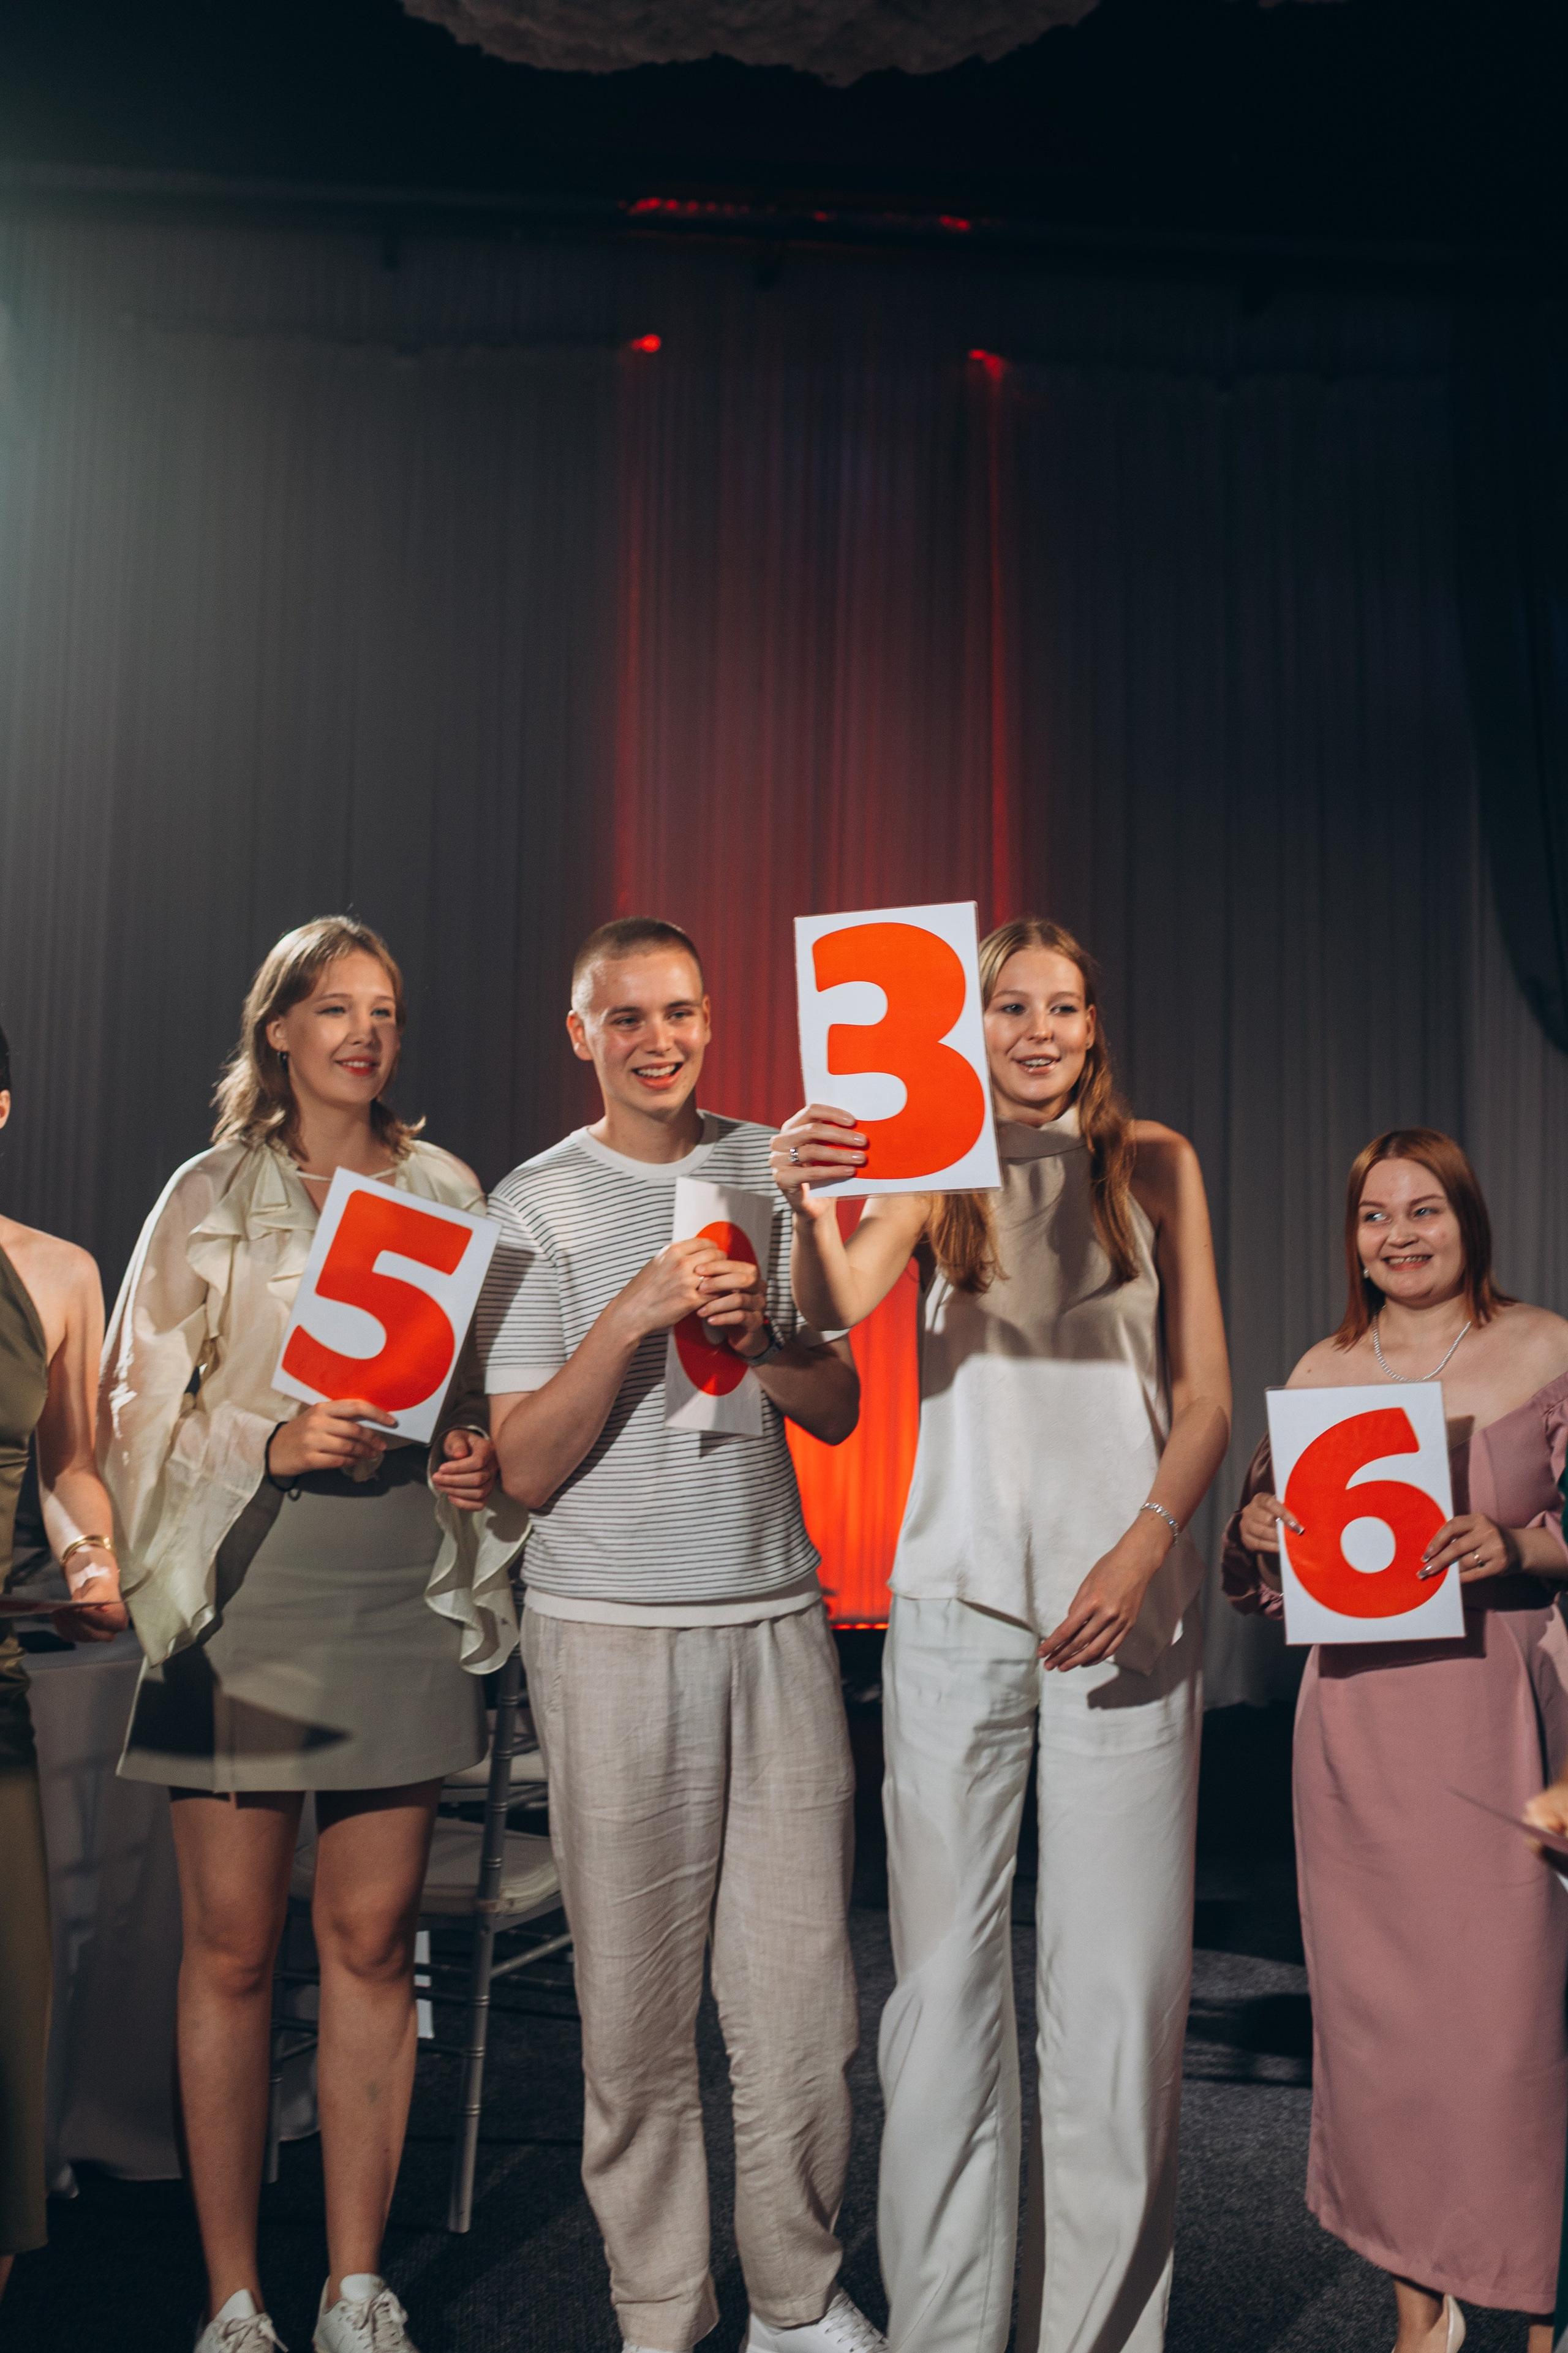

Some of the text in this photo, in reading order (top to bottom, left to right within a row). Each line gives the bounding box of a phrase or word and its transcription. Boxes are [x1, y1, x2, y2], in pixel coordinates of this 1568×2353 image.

[812, 923, 985, 1179] 3
[282, 1190, 472, 1412] 5
[1283, 1407, 1449, 1618] 6
